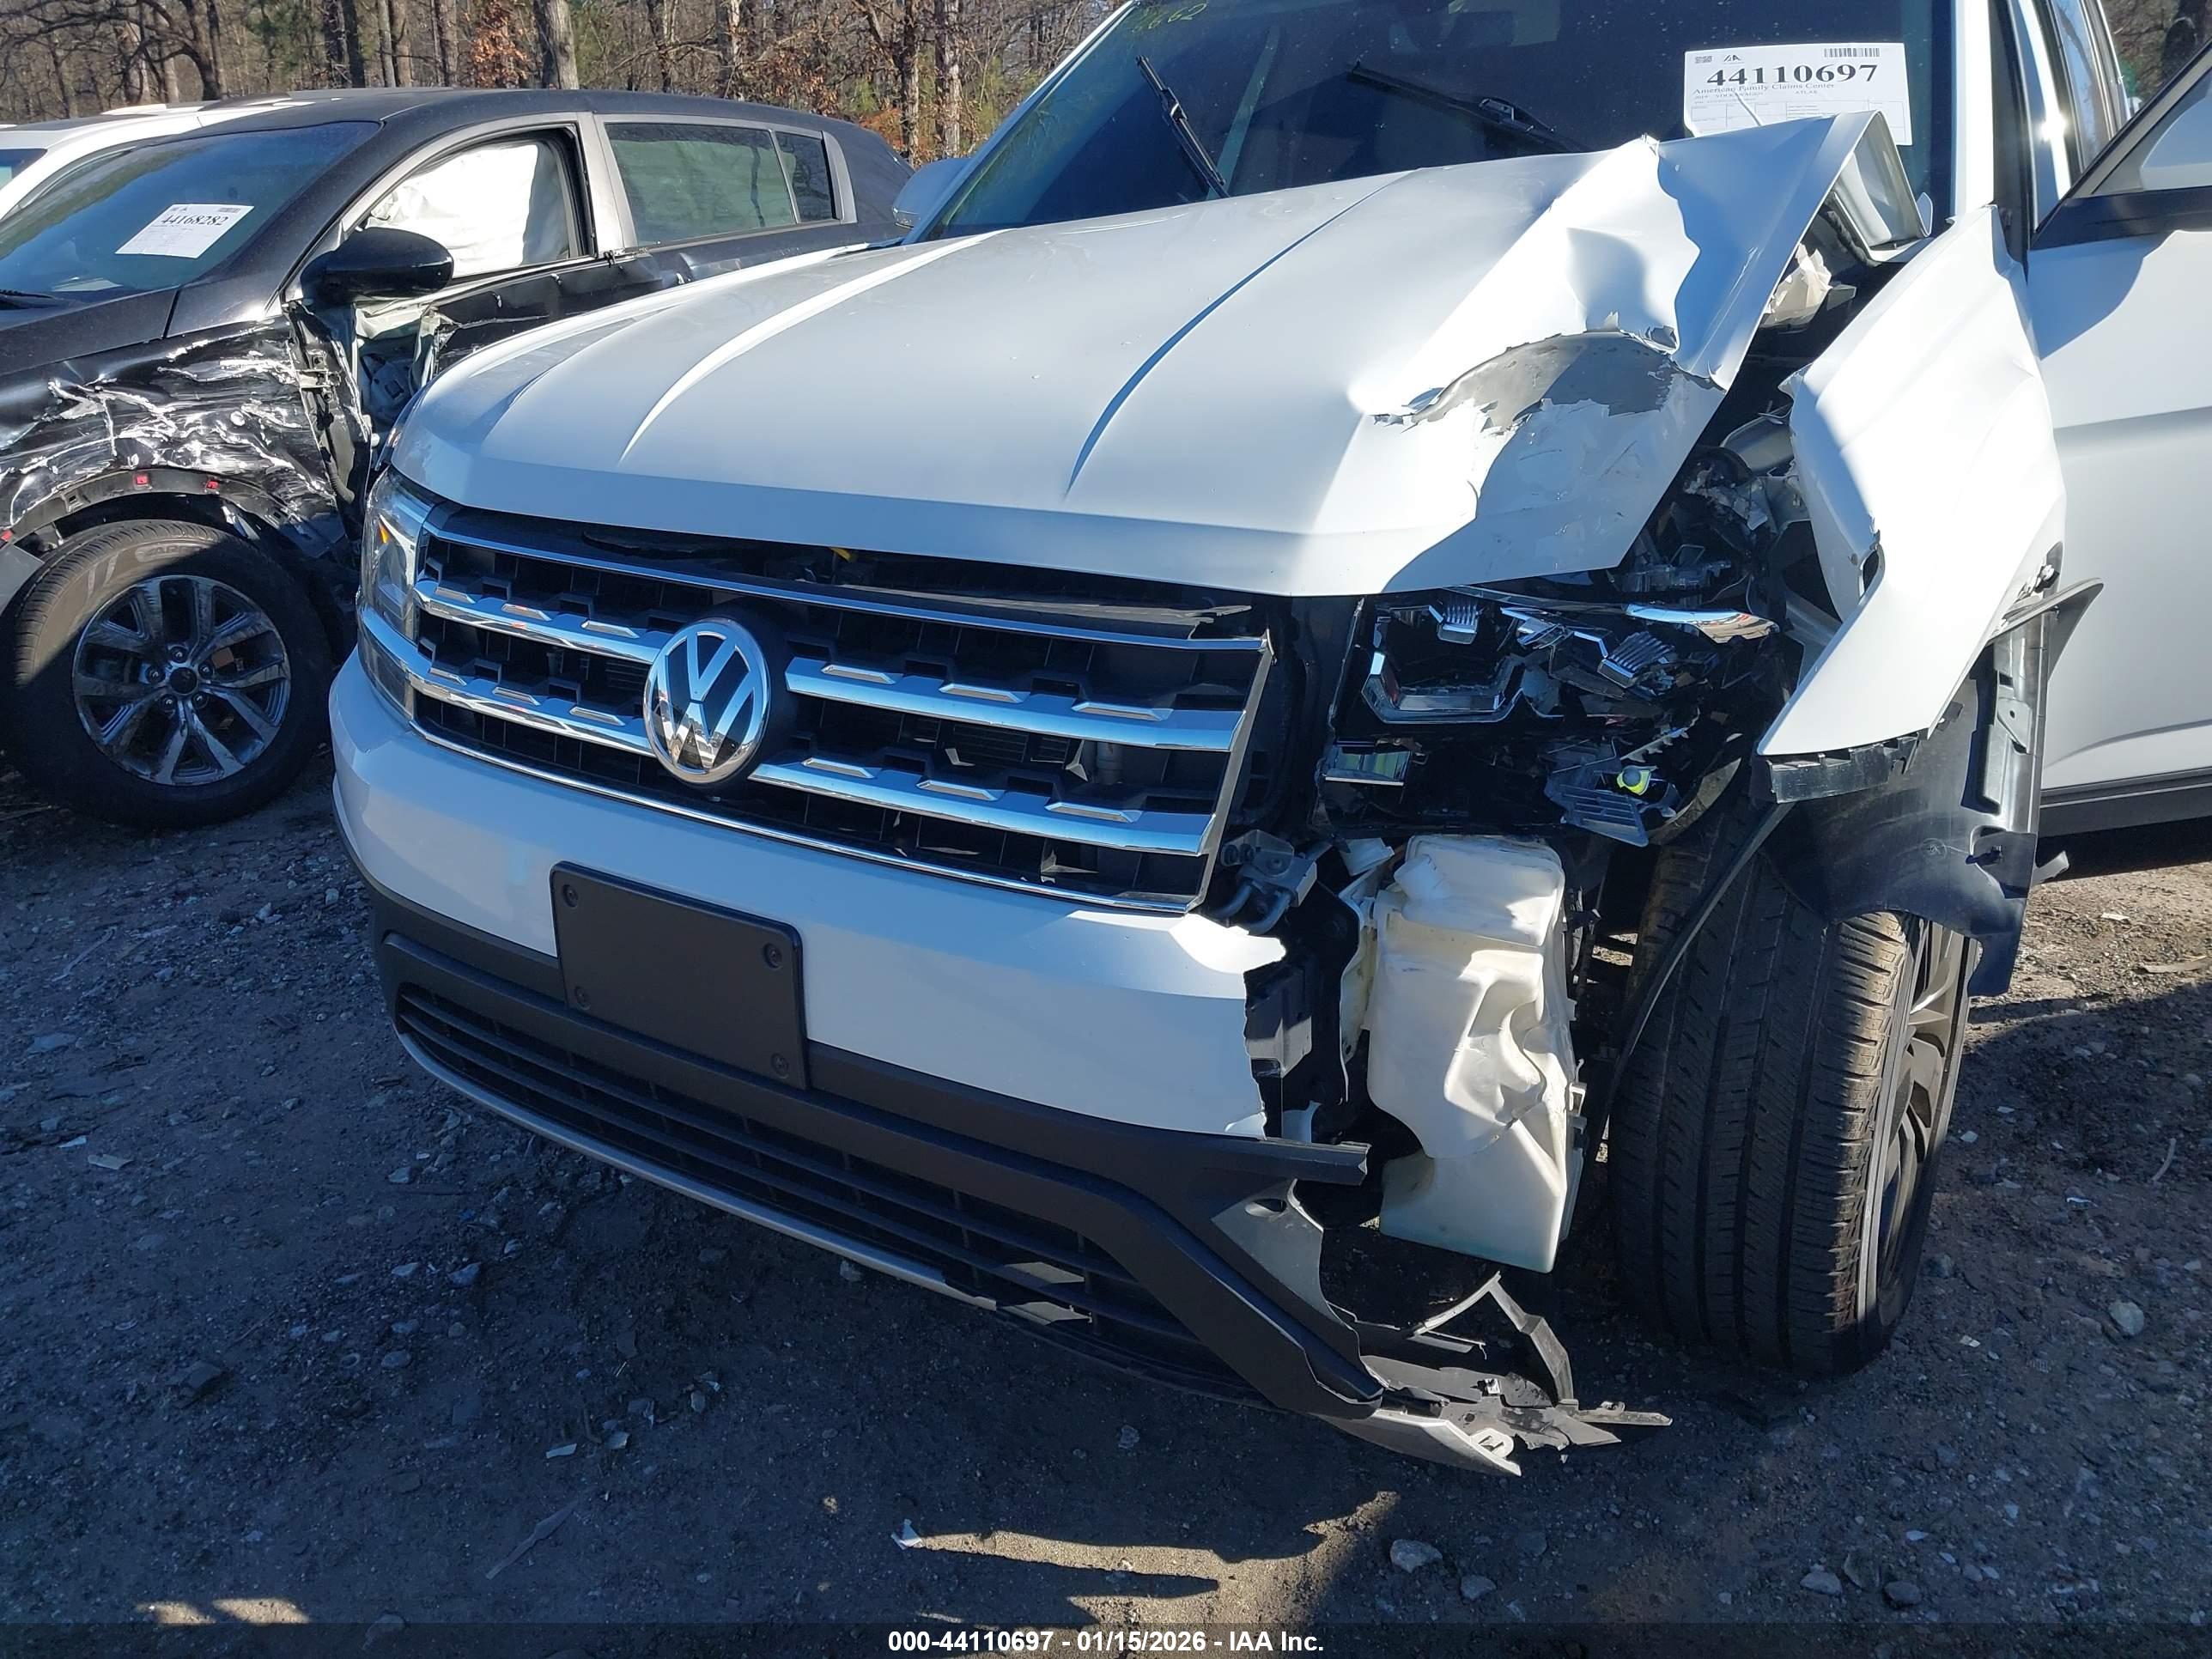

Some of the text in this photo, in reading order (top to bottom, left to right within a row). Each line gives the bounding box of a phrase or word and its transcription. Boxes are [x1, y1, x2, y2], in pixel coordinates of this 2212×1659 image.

[1706, 64, 1879, 86] 44110697
[1693, 86, 1736, 95] American
[1739, 83, 1768, 93] Family
[161, 215, 229, 226] 44168282
